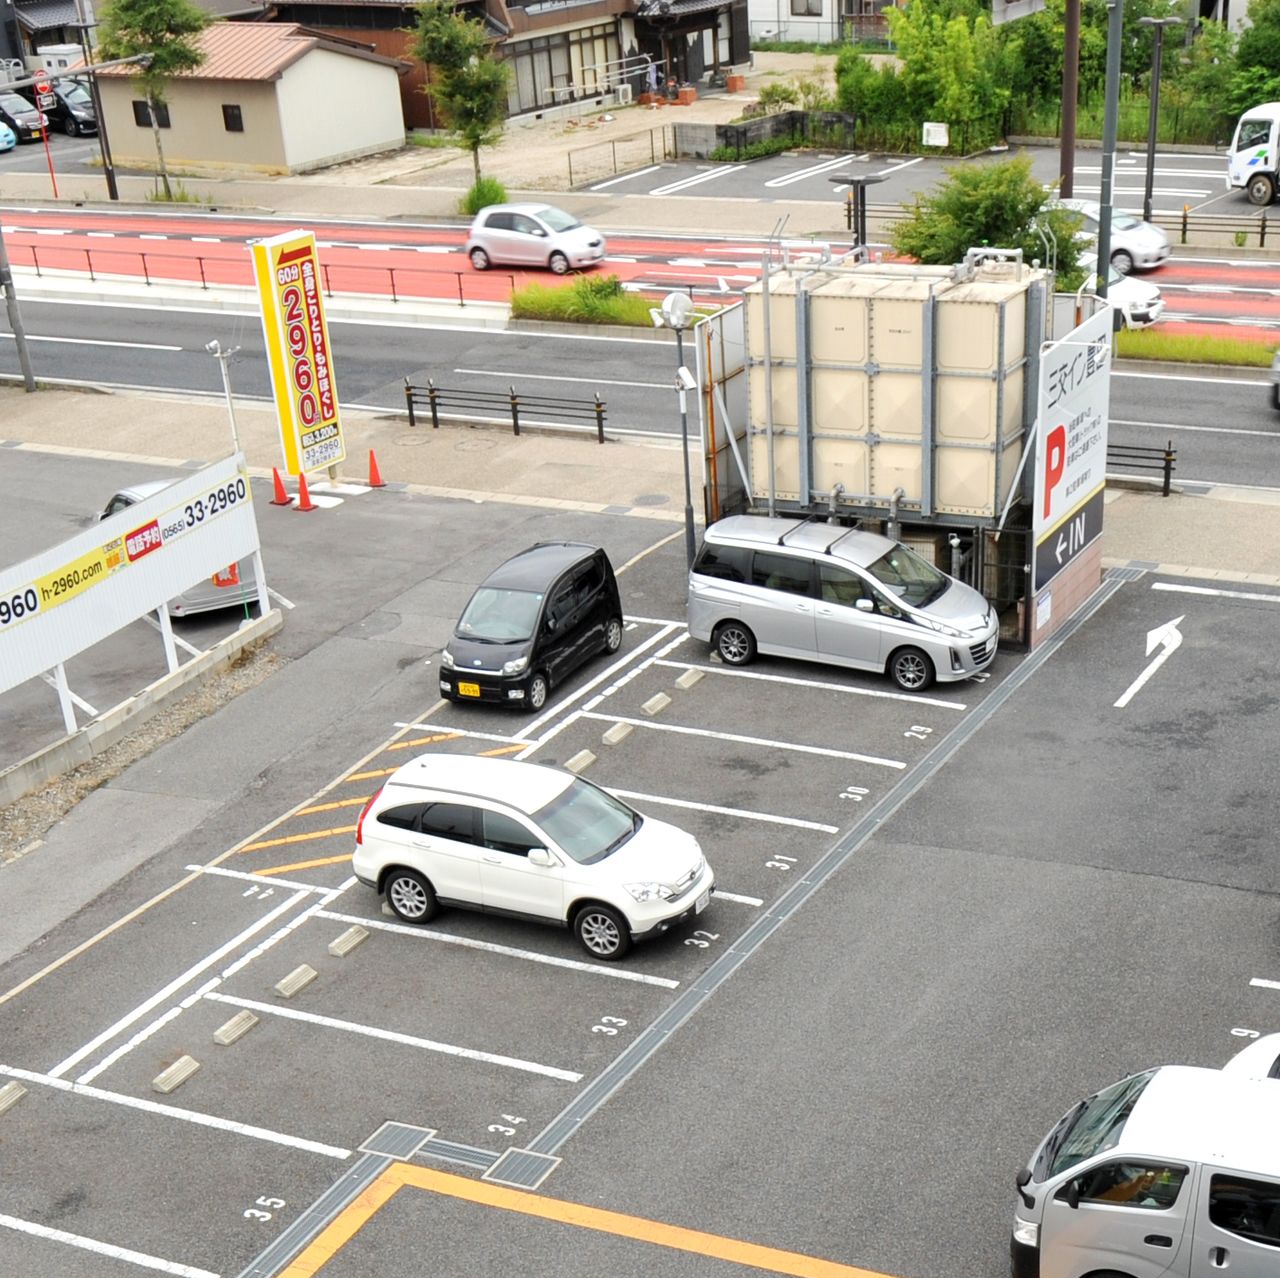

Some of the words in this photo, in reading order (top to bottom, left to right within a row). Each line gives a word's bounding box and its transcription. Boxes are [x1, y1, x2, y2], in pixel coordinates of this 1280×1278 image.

[301, 261, 333, 419] 全身こりとり・もみほぐし
[305, 440, 339, 460] 33-2960
[42, 560, 104, 602] h-2960.com
[126, 525, 161, 555] 電話予約
[161, 519, 185, 542] (0565)
[184, 477, 247, 528] 33-2960
[1070, 512, 1086, 556] IN
[904, 724, 933, 740] 29
[839, 786, 870, 802] 30
[765, 854, 798, 871] 31
[684, 930, 721, 948] 32
[591, 1015, 628, 1036] 33
[487, 1113, 527, 1136] 34
[243, 1194, 287, 1222] 35
